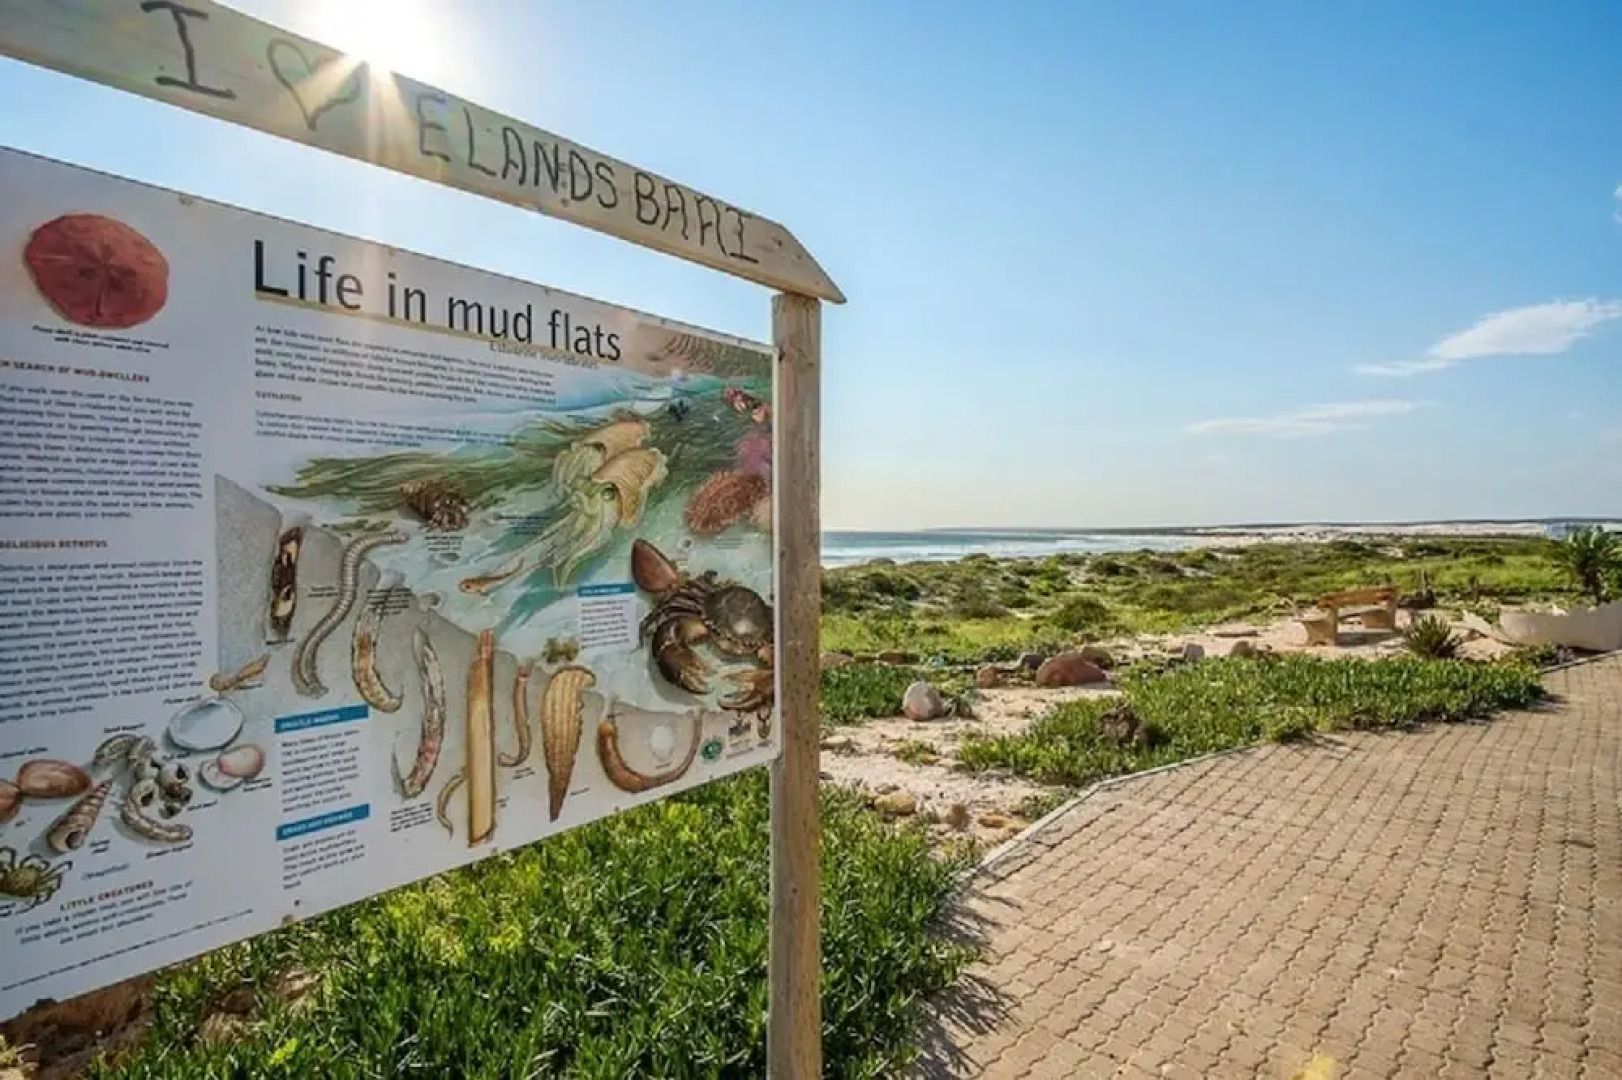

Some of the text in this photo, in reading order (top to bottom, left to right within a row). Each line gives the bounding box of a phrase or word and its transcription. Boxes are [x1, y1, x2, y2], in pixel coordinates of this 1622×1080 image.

[141, 0, 761, 265] I ELANDS BAAI
[253, 239, 364, 312] Life
[387, 272, 427, 324] in
[448, 296, 533, 344] mud
[547, 309, 623, 362] flats
